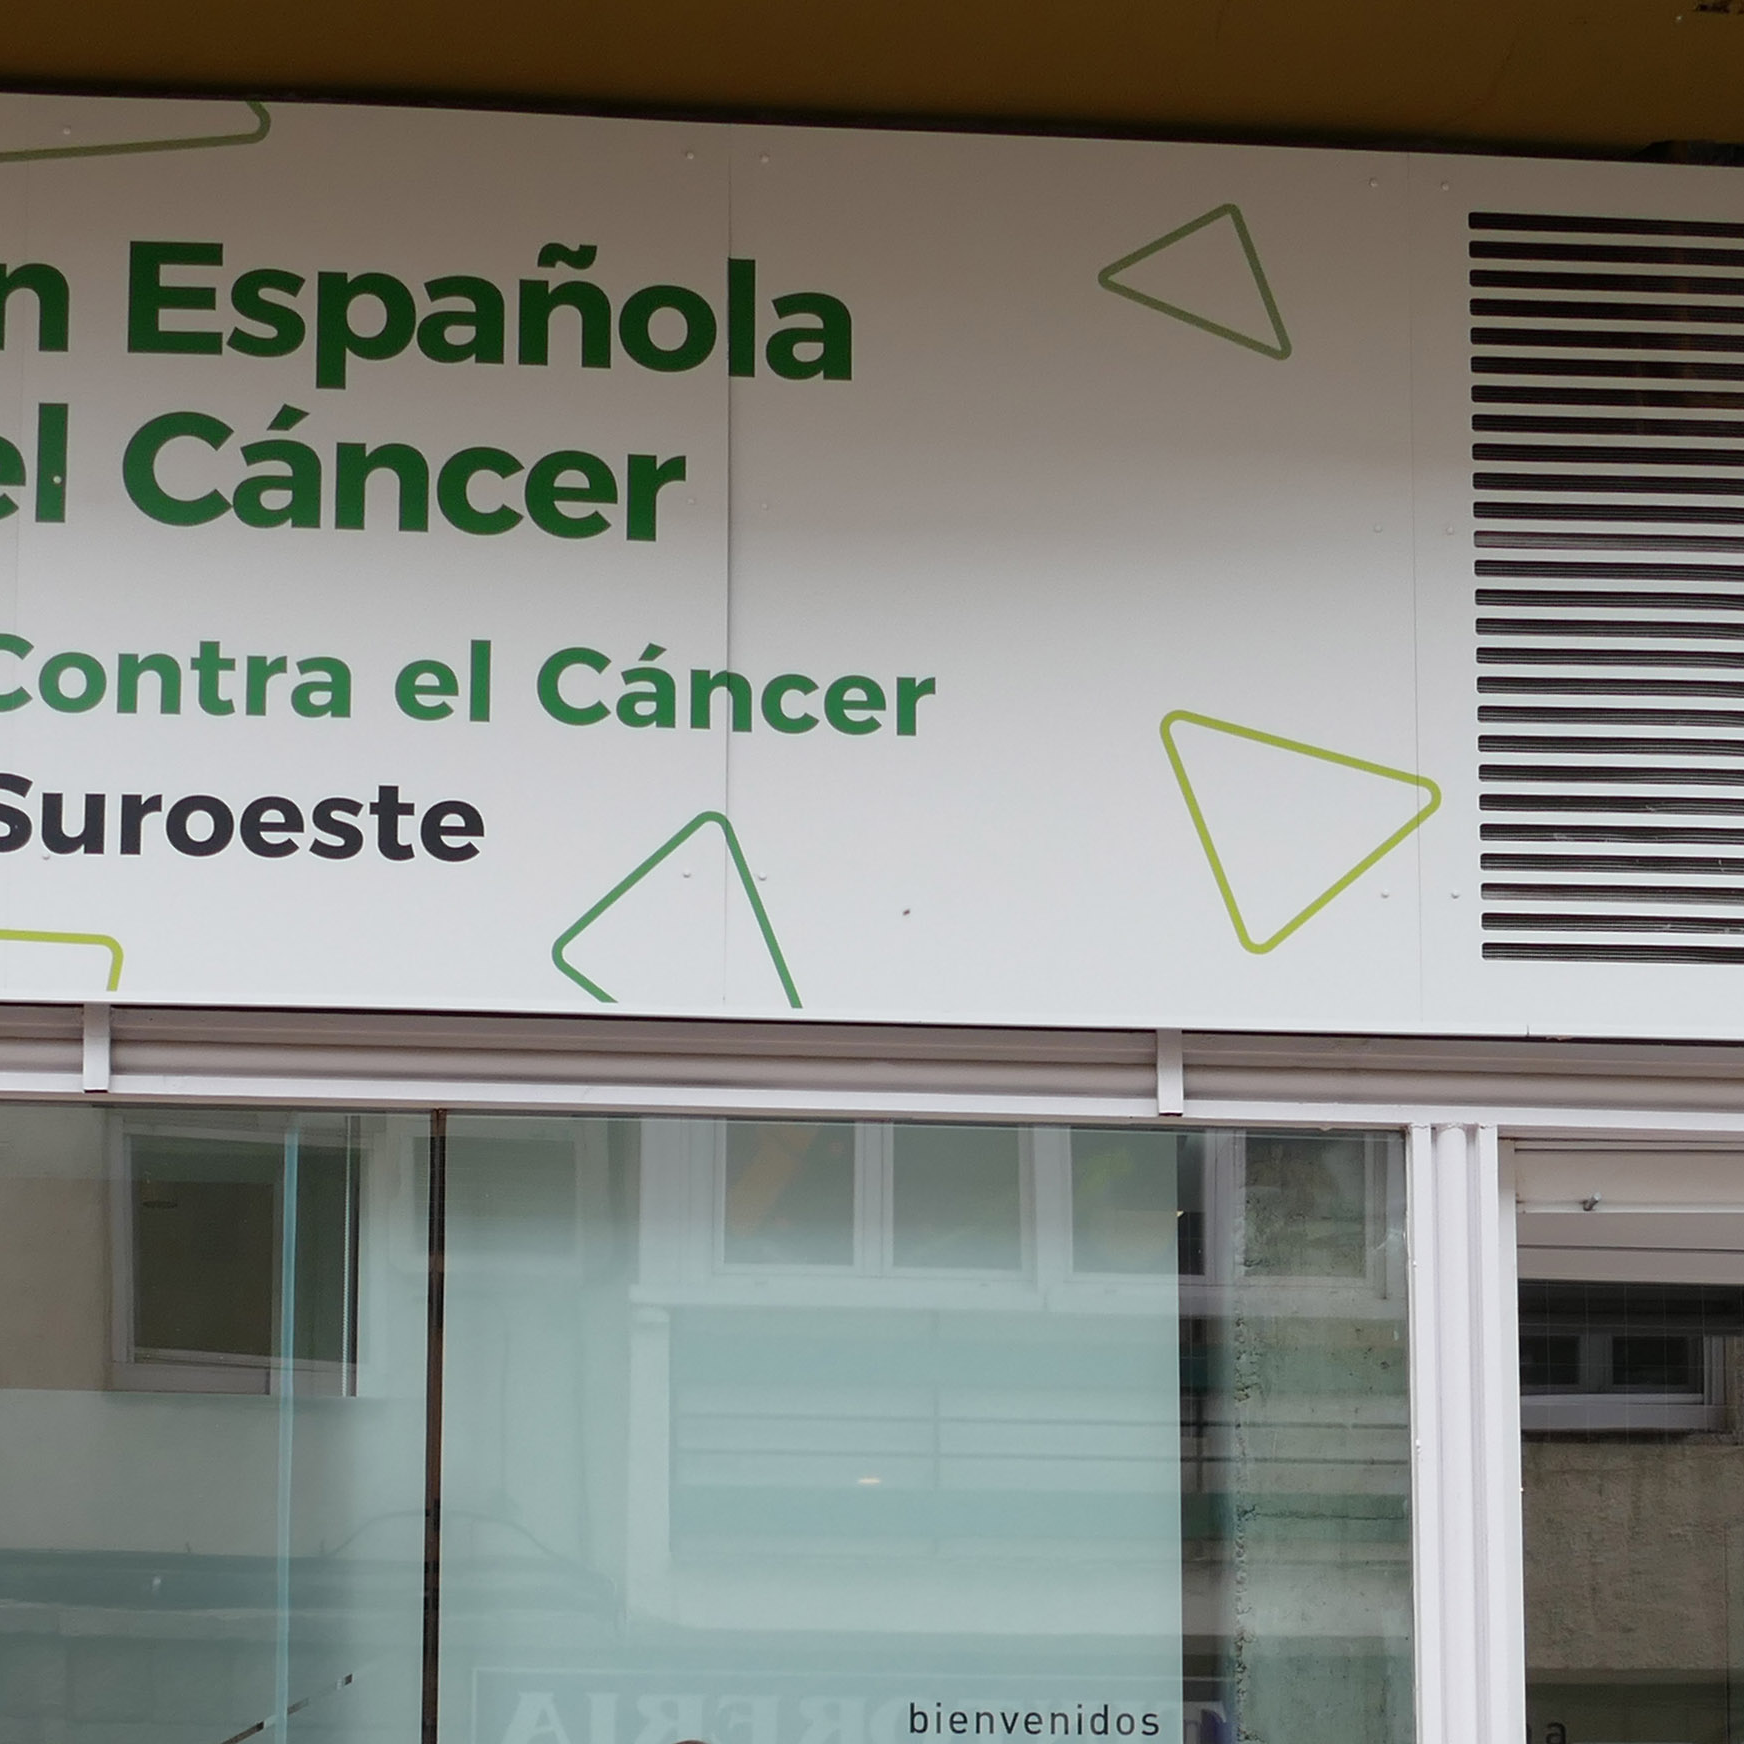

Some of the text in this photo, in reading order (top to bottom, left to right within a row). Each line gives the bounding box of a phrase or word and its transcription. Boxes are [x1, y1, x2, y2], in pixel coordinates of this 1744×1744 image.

[128, 241, 852, 389] Española
[123, 404, 686, 541] Cáncer
[395, 640, 491, 722] el
[537, 643, 936, 736] Cáncer
[909, 1702, 1160, 1736] bienvenidos
